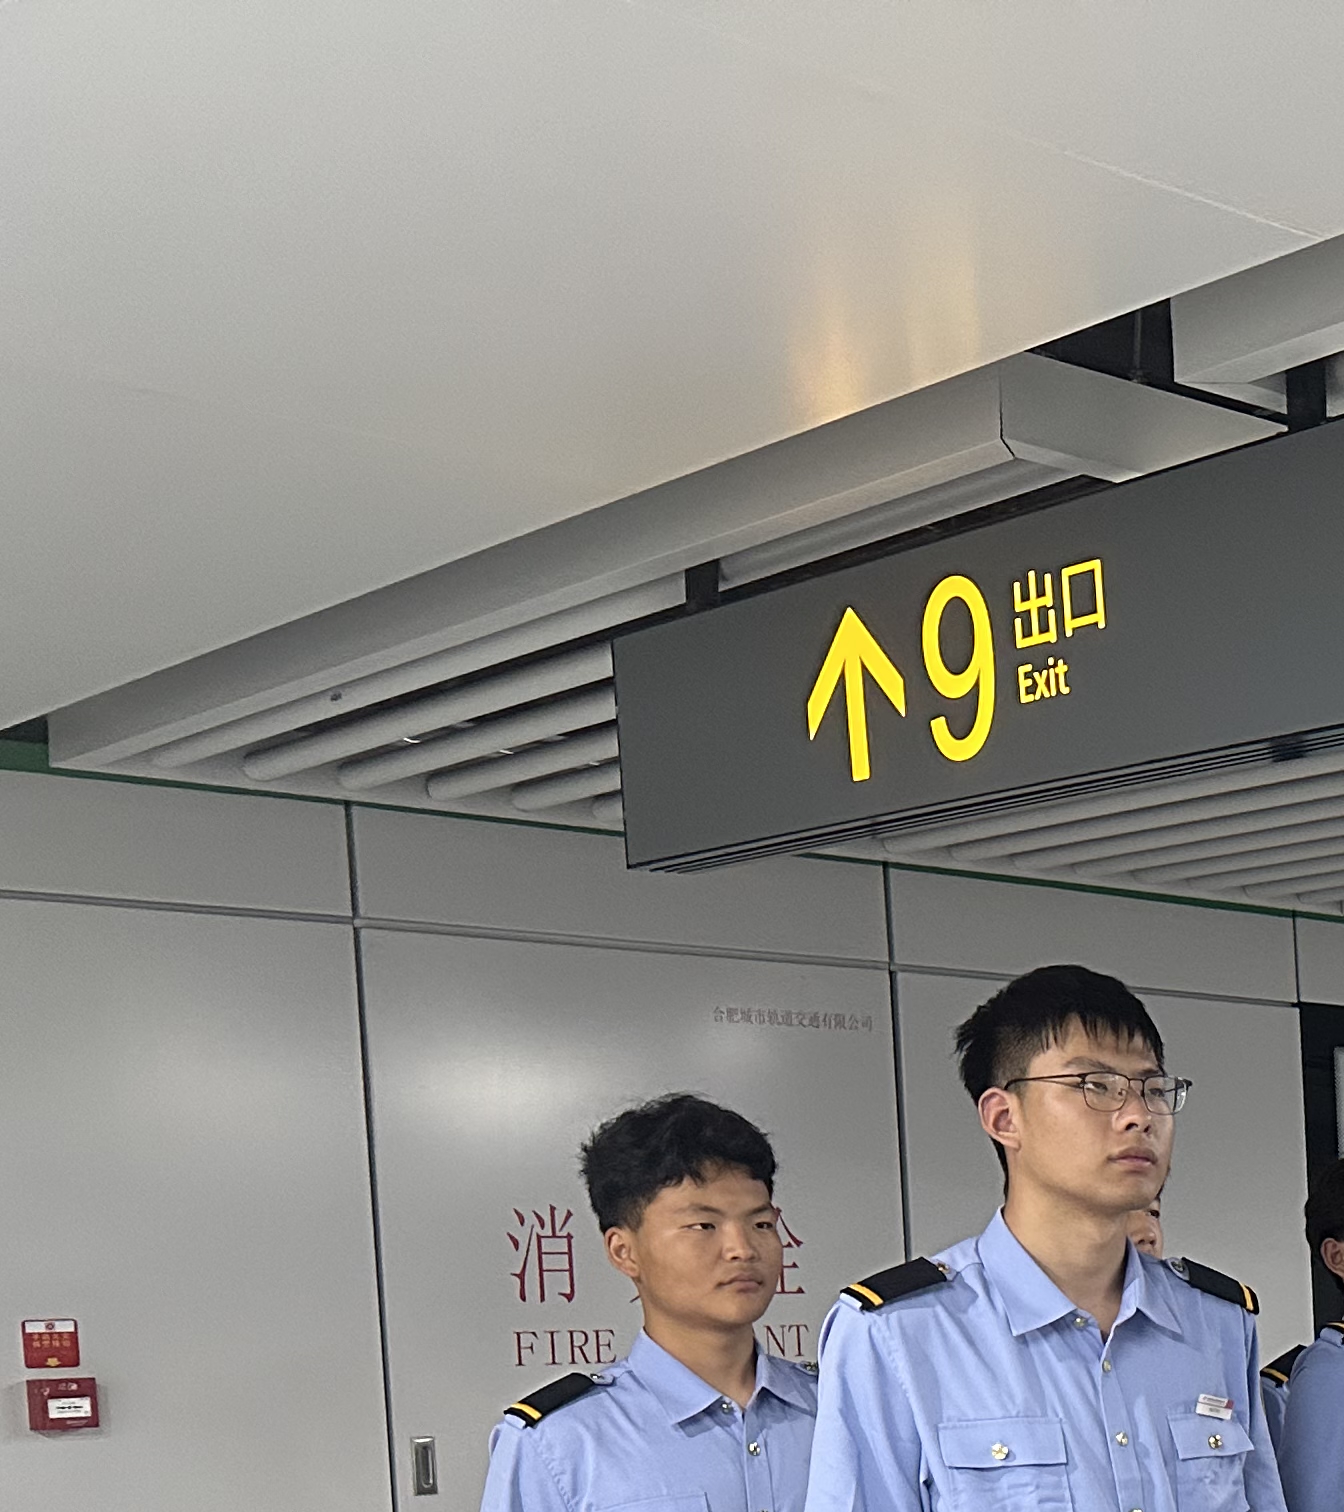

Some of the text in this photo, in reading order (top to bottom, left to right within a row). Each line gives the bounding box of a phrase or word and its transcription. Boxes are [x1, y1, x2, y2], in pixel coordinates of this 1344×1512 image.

[1012, 558, 1107, 649] 出口
[921, 574, 996, 763] 9
[1017, 657, 1071, 704] Exit
[513, 1330, 616, 1366] FIRE
